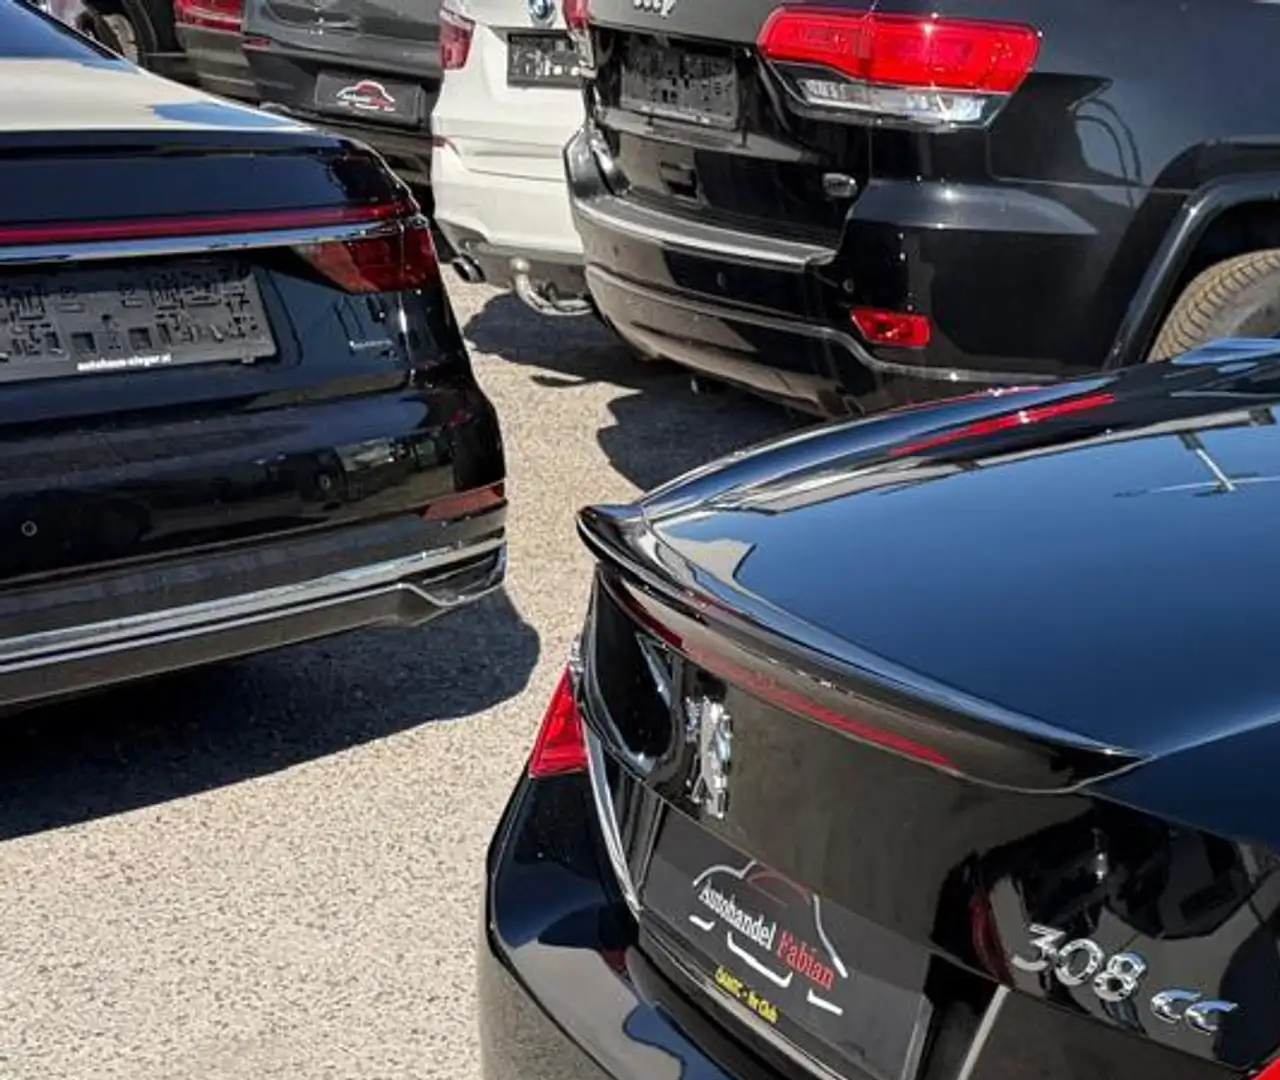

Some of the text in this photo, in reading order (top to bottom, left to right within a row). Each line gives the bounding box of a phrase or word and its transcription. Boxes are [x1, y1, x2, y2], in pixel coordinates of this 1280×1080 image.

[699, 877, 835, 990] Autohandel Fabian
[1011, 923, 1238, 1035] 308 CC
